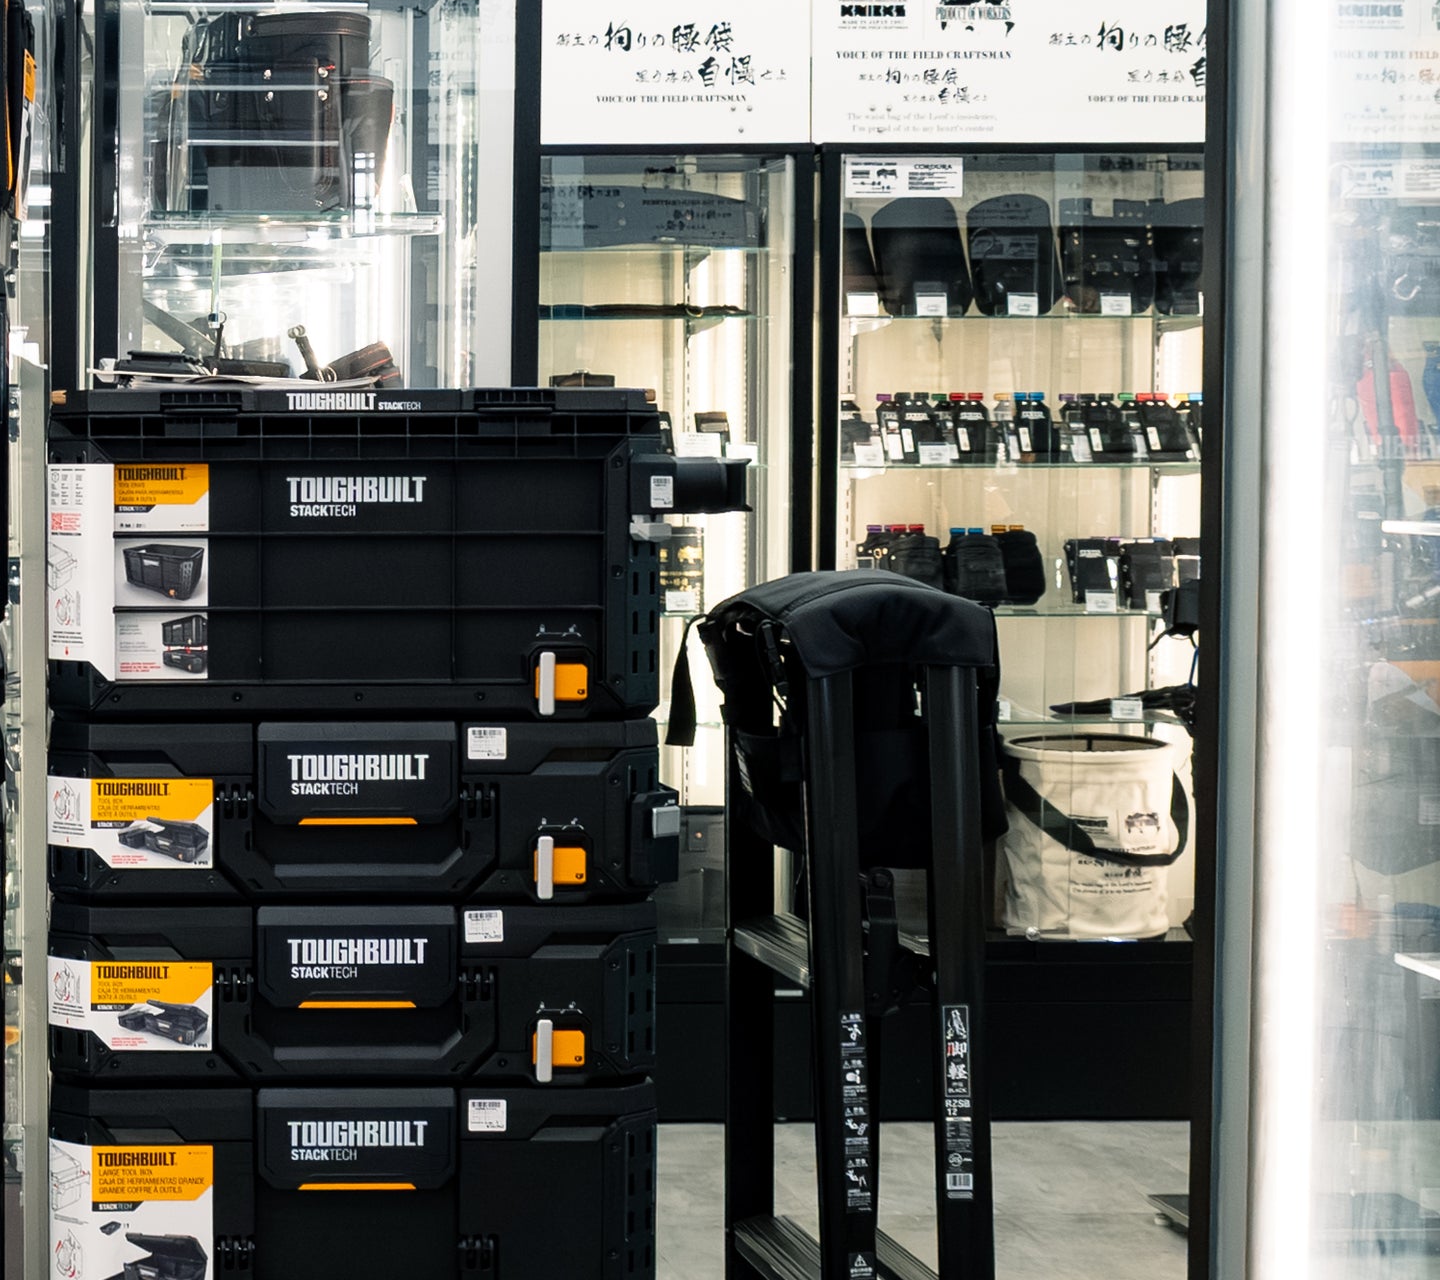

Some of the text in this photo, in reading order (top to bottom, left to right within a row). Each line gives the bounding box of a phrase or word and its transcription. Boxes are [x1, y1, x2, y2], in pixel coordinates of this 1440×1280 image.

[836, 50, 1012, 60] VOICE OF THE FIELD CRAFTSMAN
[596, 94, 747, 103] VOICE OF THE FIELD CRAFTSMAN
[1087, 94, 1179, 103] VOICE OF THE FIELD
[285, 392, 377, 411] TOUGHBUILT
[377, 399, 422, 411] STACKTECH
[285, 475, 427, 503] TOUGHBUILT
[289, 504, 357, 518] STACKTECH
[287, 753, 430, 781] TOUGHBUILT
[95, 782, 170, 797] TOUGHBUILT
[290, 781, 359, 796] STACKTECH
[287, 938, 428, 966] TOUGHBUILT
[290, 965, 358, 979] STACKTECH
[286, 1119, 429, 1149] TOUGHBUILT
[96, 1151, 177, 1167] TOUGHBUILT
[290, 1148, 359, 1162] STACKTECH
